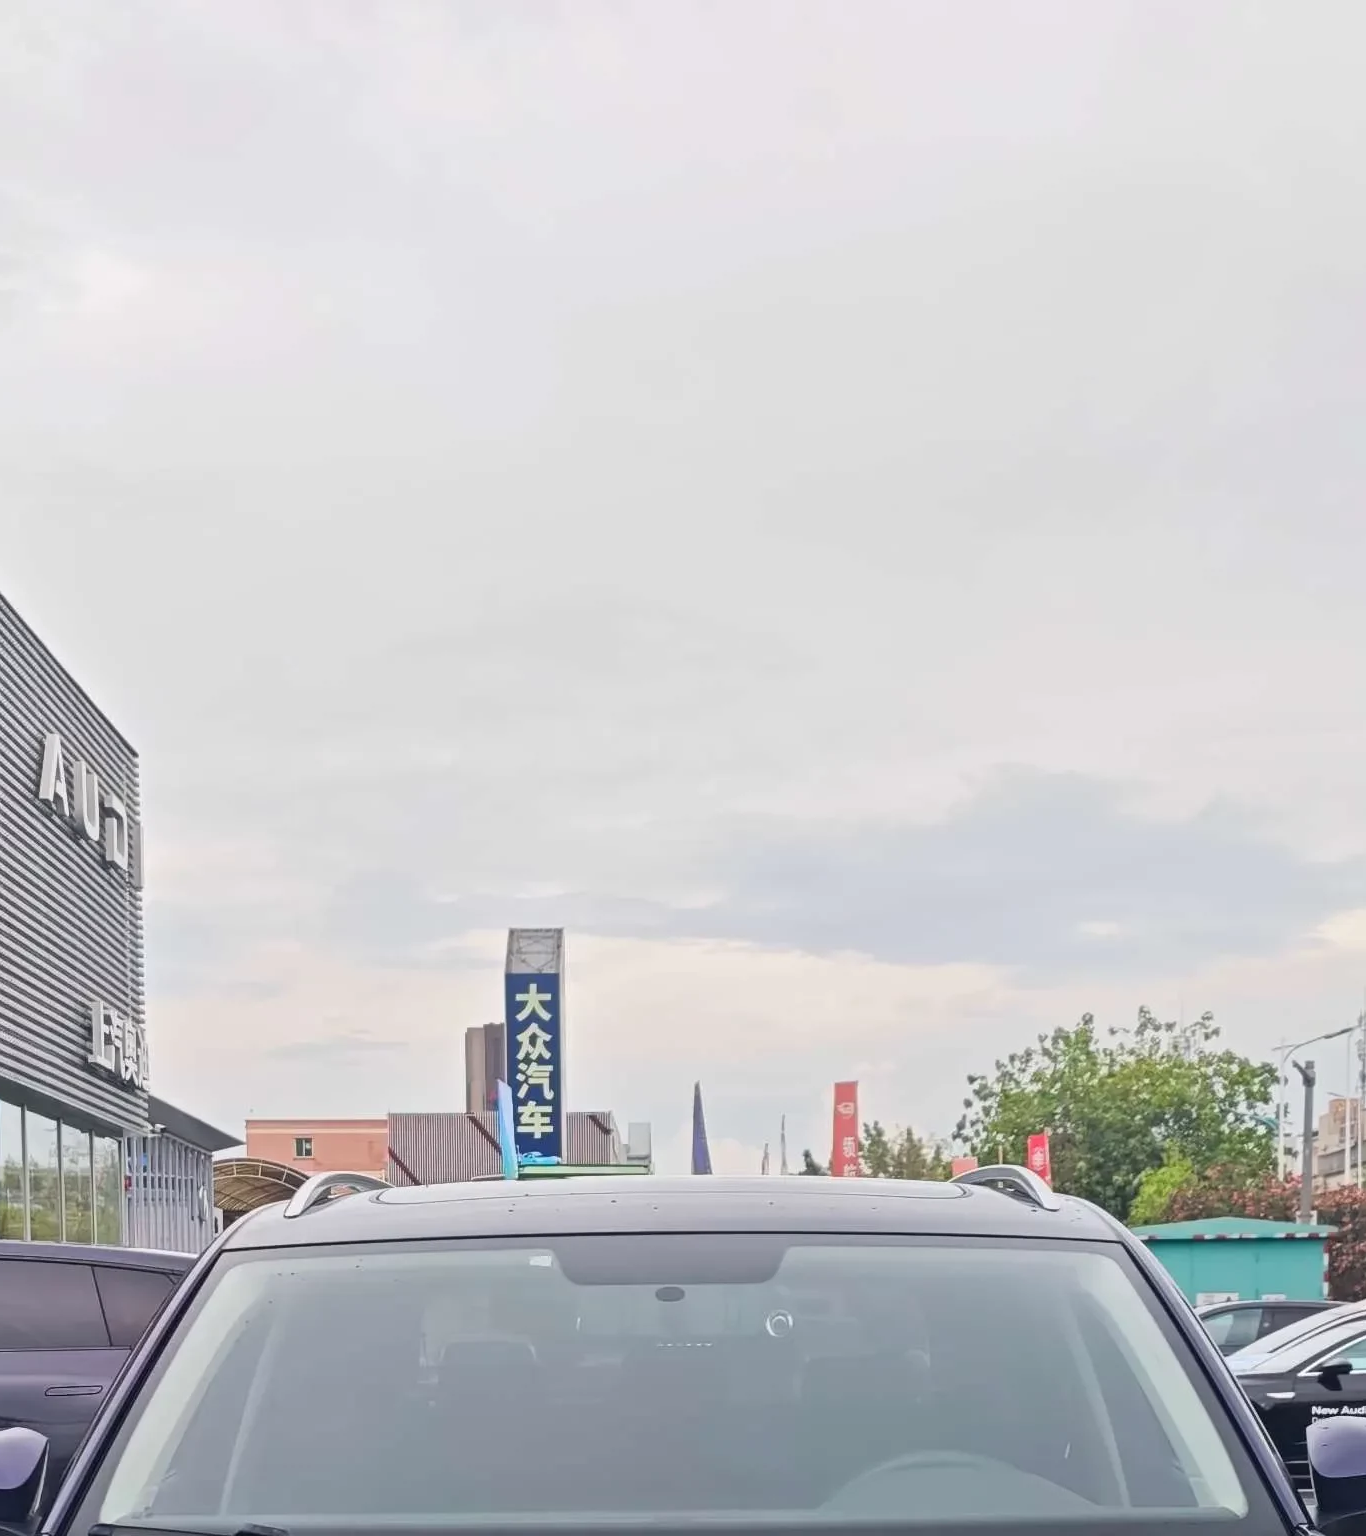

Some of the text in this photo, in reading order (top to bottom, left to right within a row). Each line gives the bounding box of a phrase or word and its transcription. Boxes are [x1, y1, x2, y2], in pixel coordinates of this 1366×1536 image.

[39, 733, 144, 889] AUDI
[515, 984, 554, 1140] 大众汽车
[1312, 1405, 1339, 1415] New
